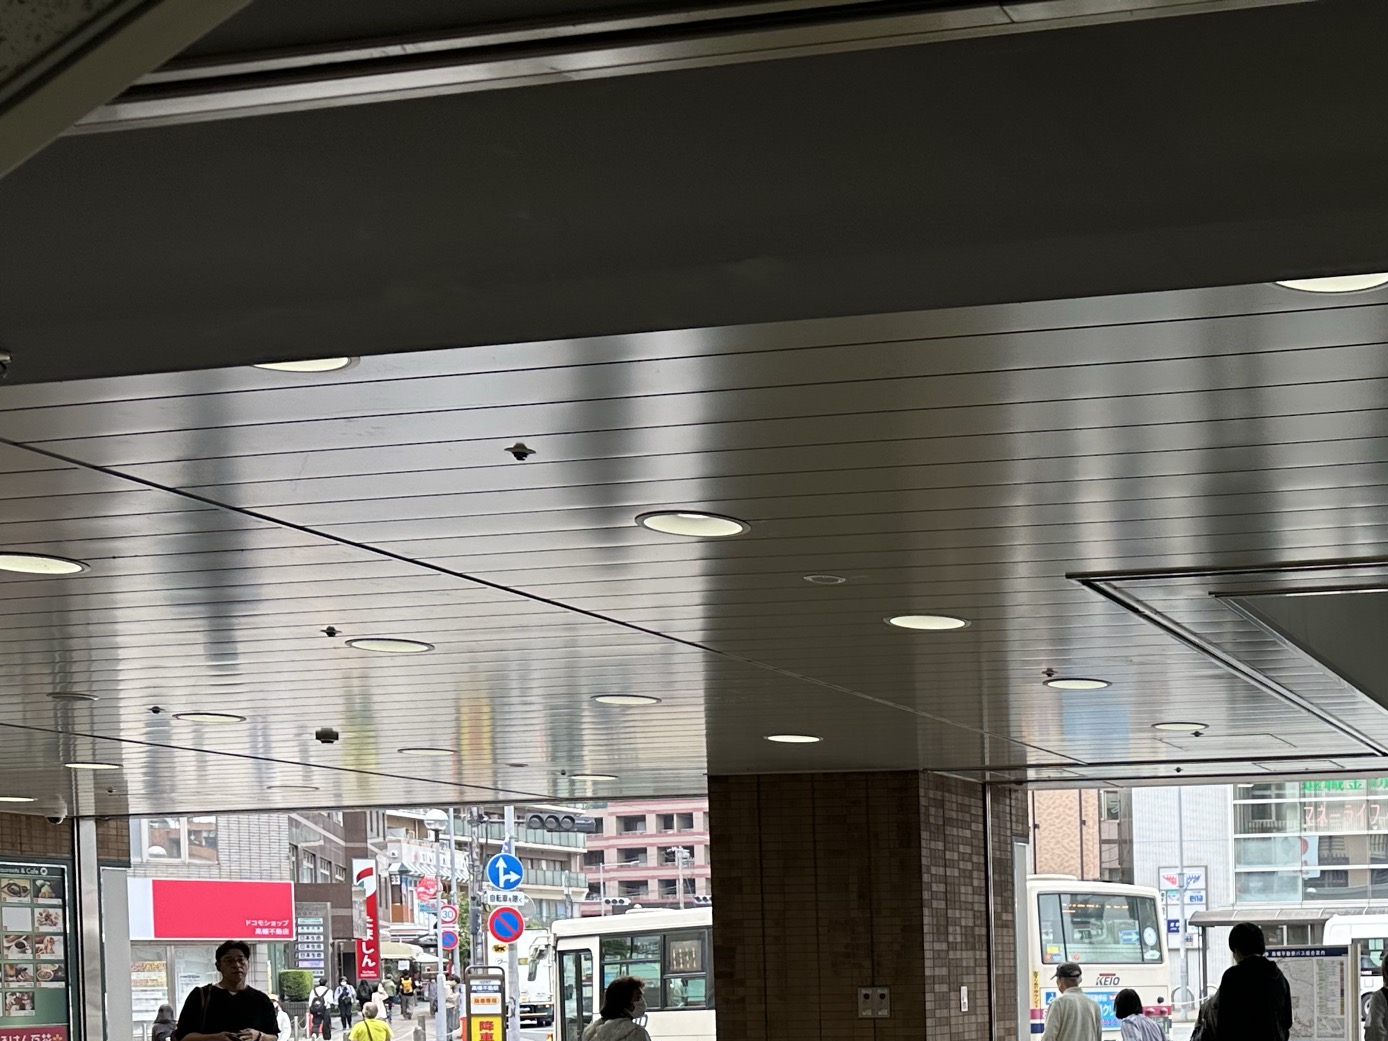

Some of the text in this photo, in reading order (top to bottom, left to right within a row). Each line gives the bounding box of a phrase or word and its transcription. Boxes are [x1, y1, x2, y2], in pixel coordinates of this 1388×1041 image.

[442, 910, 454, 919] 30
[245, 919, 290, 927] ドコモショップ
[1095, 976, 1120, 986] KEIO
